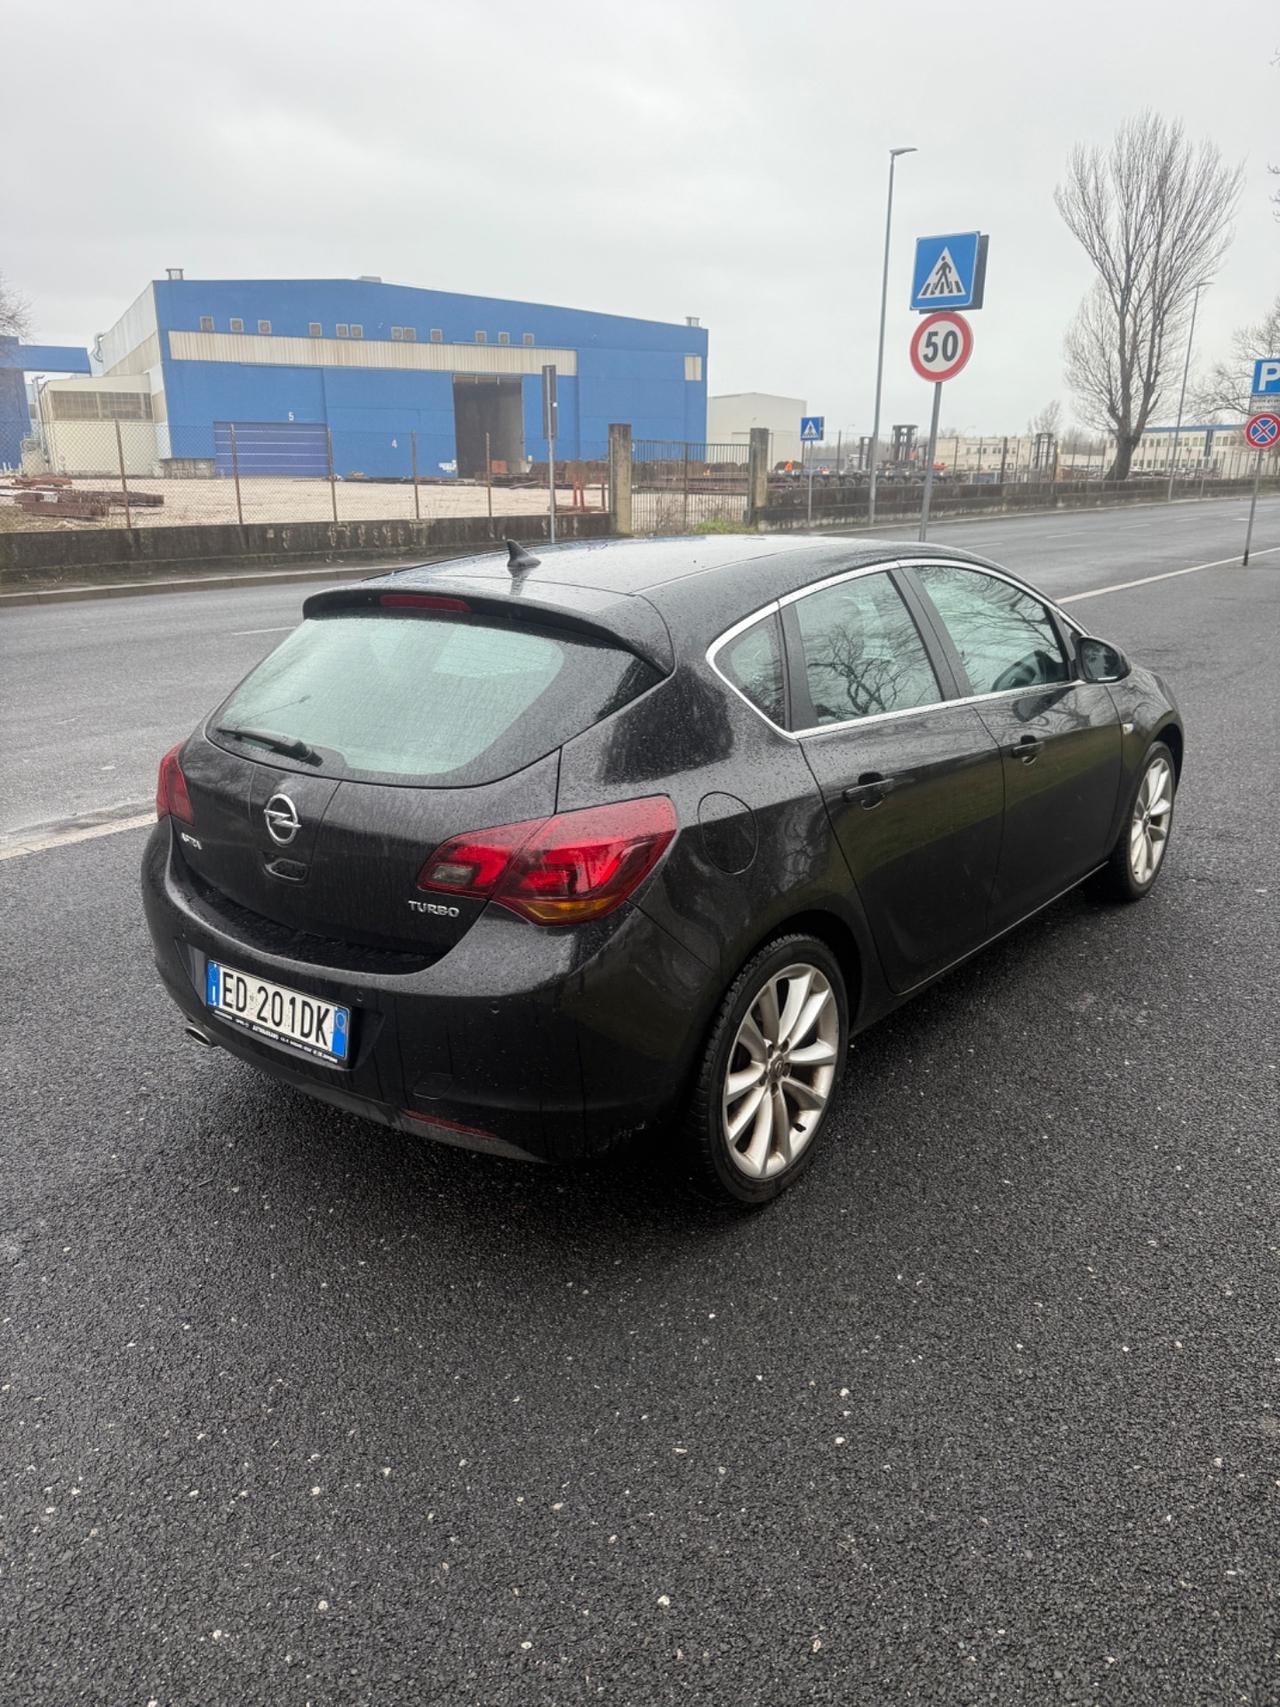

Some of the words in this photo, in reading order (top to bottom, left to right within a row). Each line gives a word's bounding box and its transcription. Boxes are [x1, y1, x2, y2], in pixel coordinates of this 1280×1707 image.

[923, 330, 958, 363] 50
[1259, 361, 1280, 391] P
[288, 411, 295, 421] 5
[408, 900, 460, 918] TURBO
[222, 971, 247, 1013] ED
[256, 985, 330, 1047] 201DK
